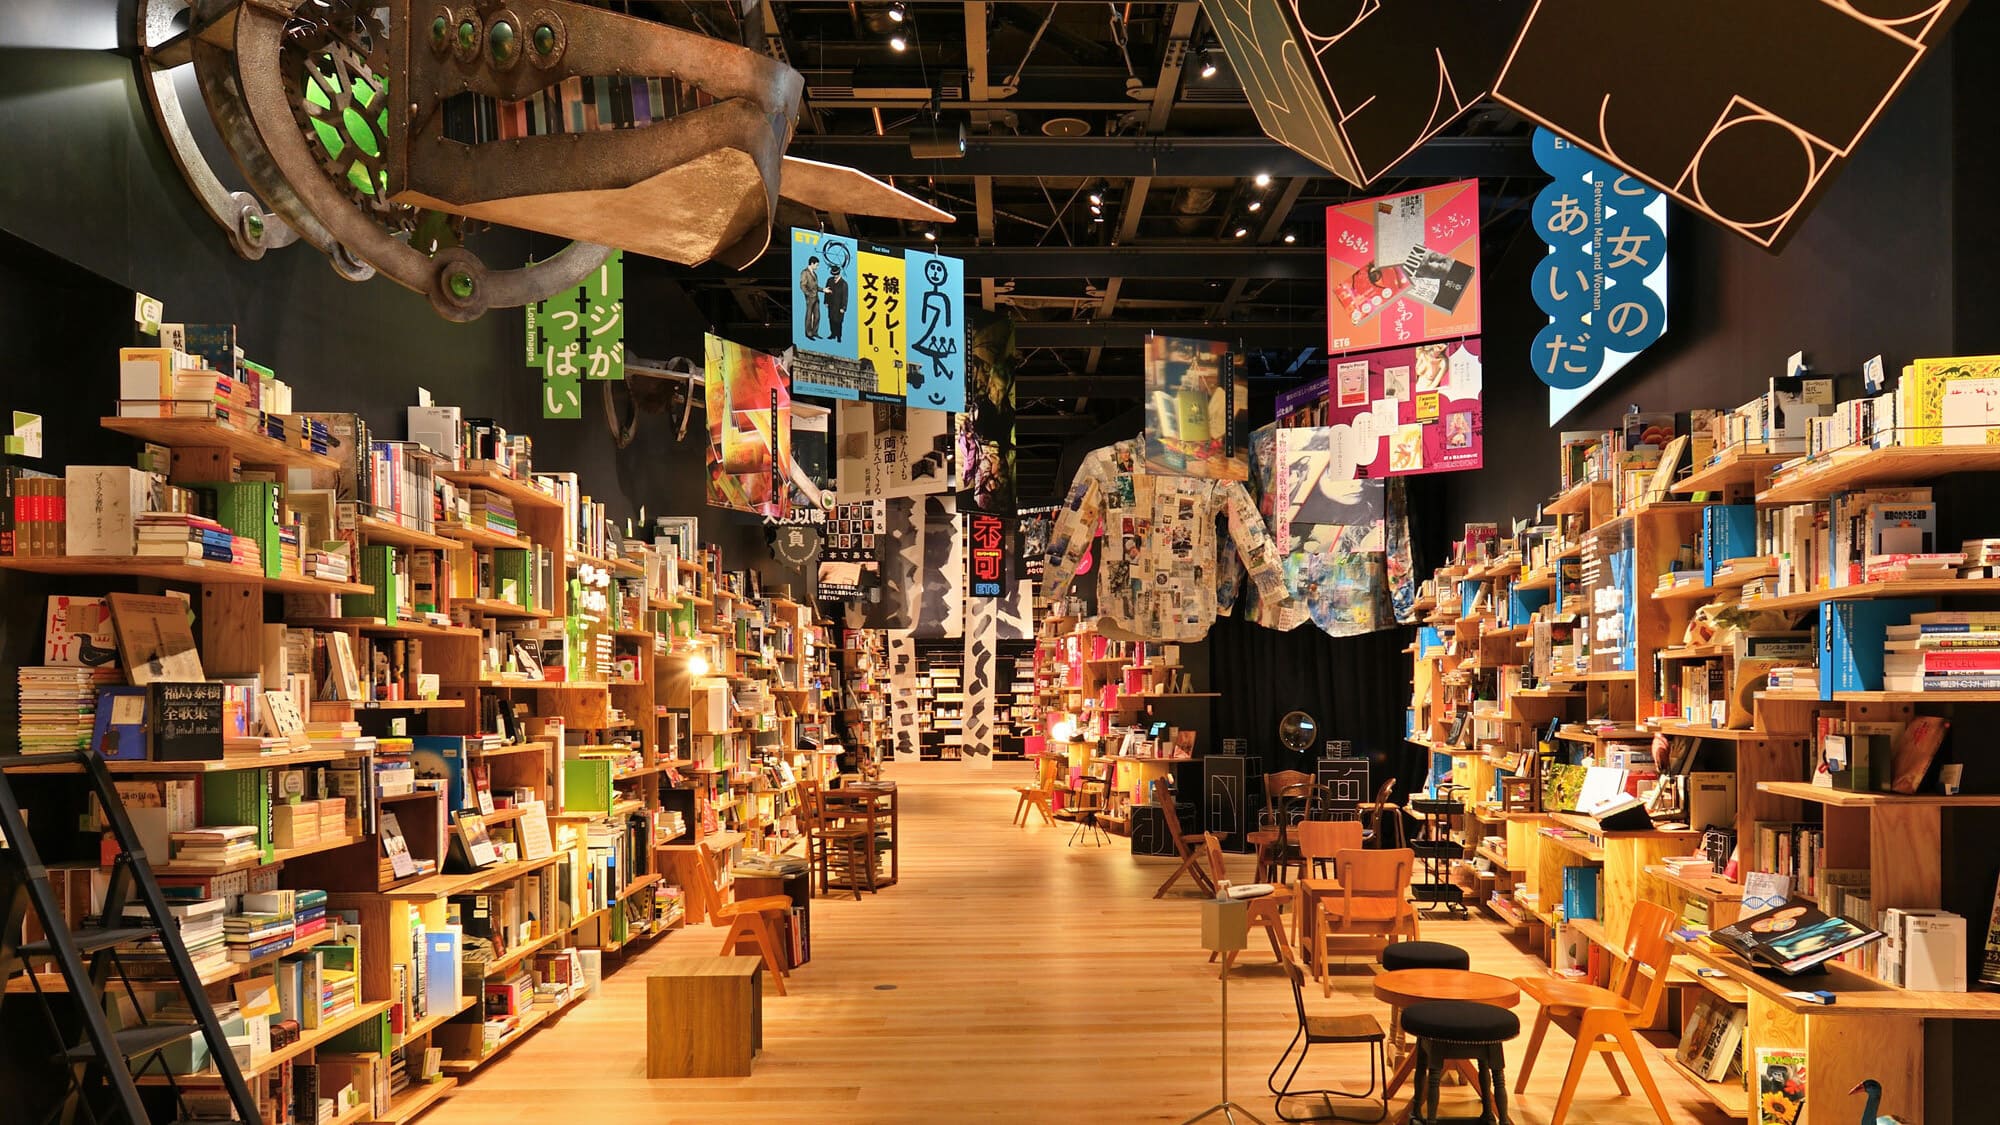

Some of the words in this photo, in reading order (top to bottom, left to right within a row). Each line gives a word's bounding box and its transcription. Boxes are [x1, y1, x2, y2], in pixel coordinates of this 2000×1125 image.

[1593, 181, 1604, 226] Between
[794, 231, 820, 246] ET7
[1593, 228, 1603, 251] Man
[1593, 253, 1602, 270] and
[1545, 193, 1590, 374] あいだ
[1593, 272, 1601, 311] Woman
[527, 307, 536, 328] Lotta
[862, 273, 880, 353] 文クノー。
[883, 276, 900, 355] 線クレー、
[526, 329, 536, 362] Images
[1333, 338, 1351, 348] ET6
[547, 311, 579, 413] っぱい
[884, 436, 896, 475] 両面に
[788, 530, 805, 548] 負
